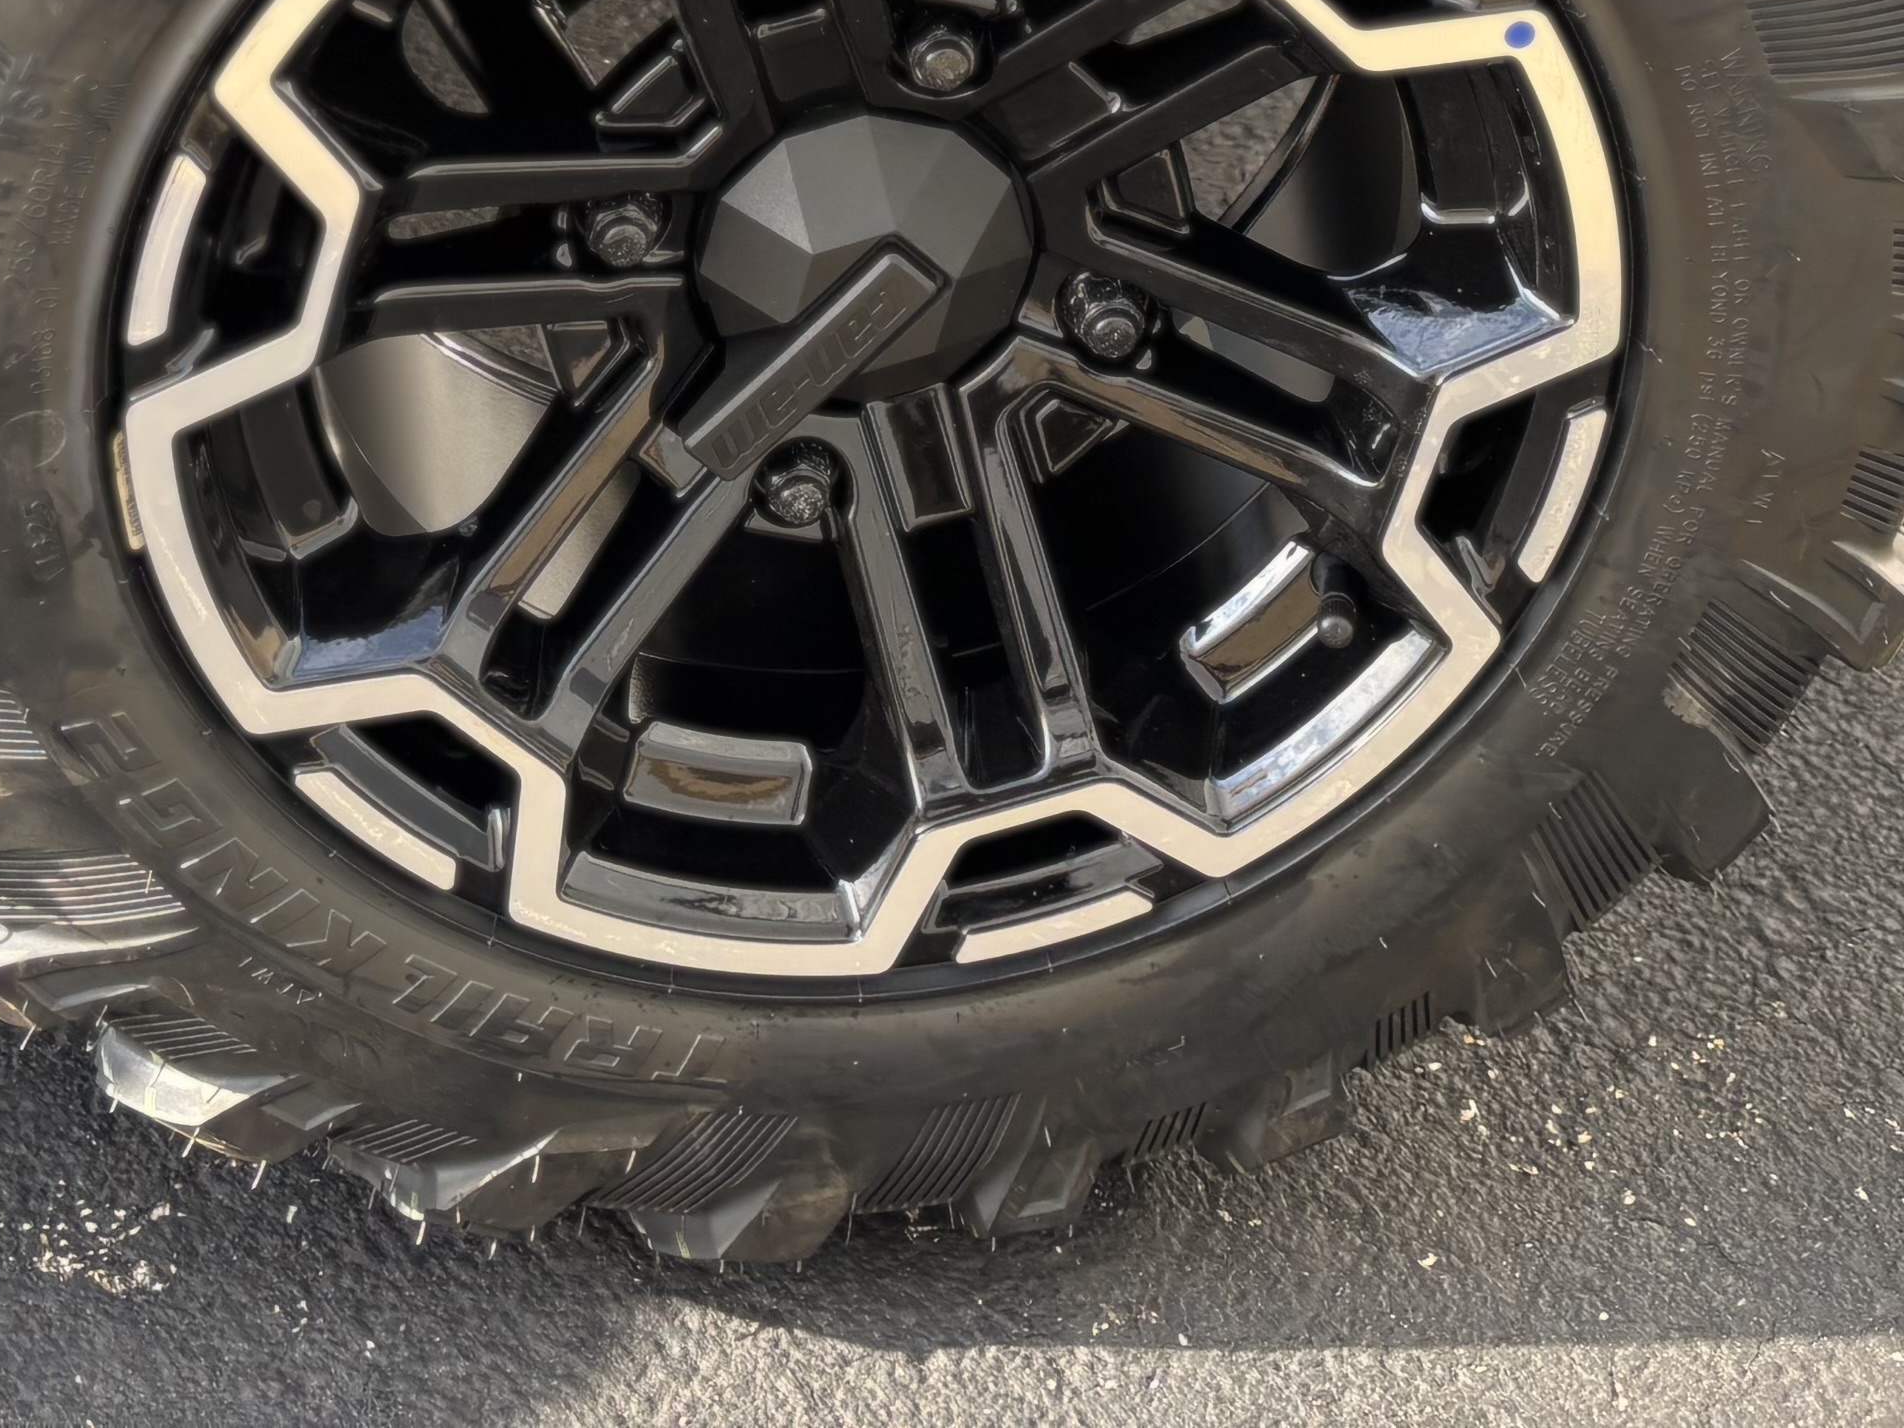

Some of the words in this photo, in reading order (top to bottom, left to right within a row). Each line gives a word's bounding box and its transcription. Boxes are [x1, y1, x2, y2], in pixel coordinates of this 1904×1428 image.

[1697, 372, 1717, 401] psi
[1677, 506, 1706, 545] FOR
[1529, 608, 1607, 705] TUBELESS
[380, 950, 735, 1084] TRAIL
